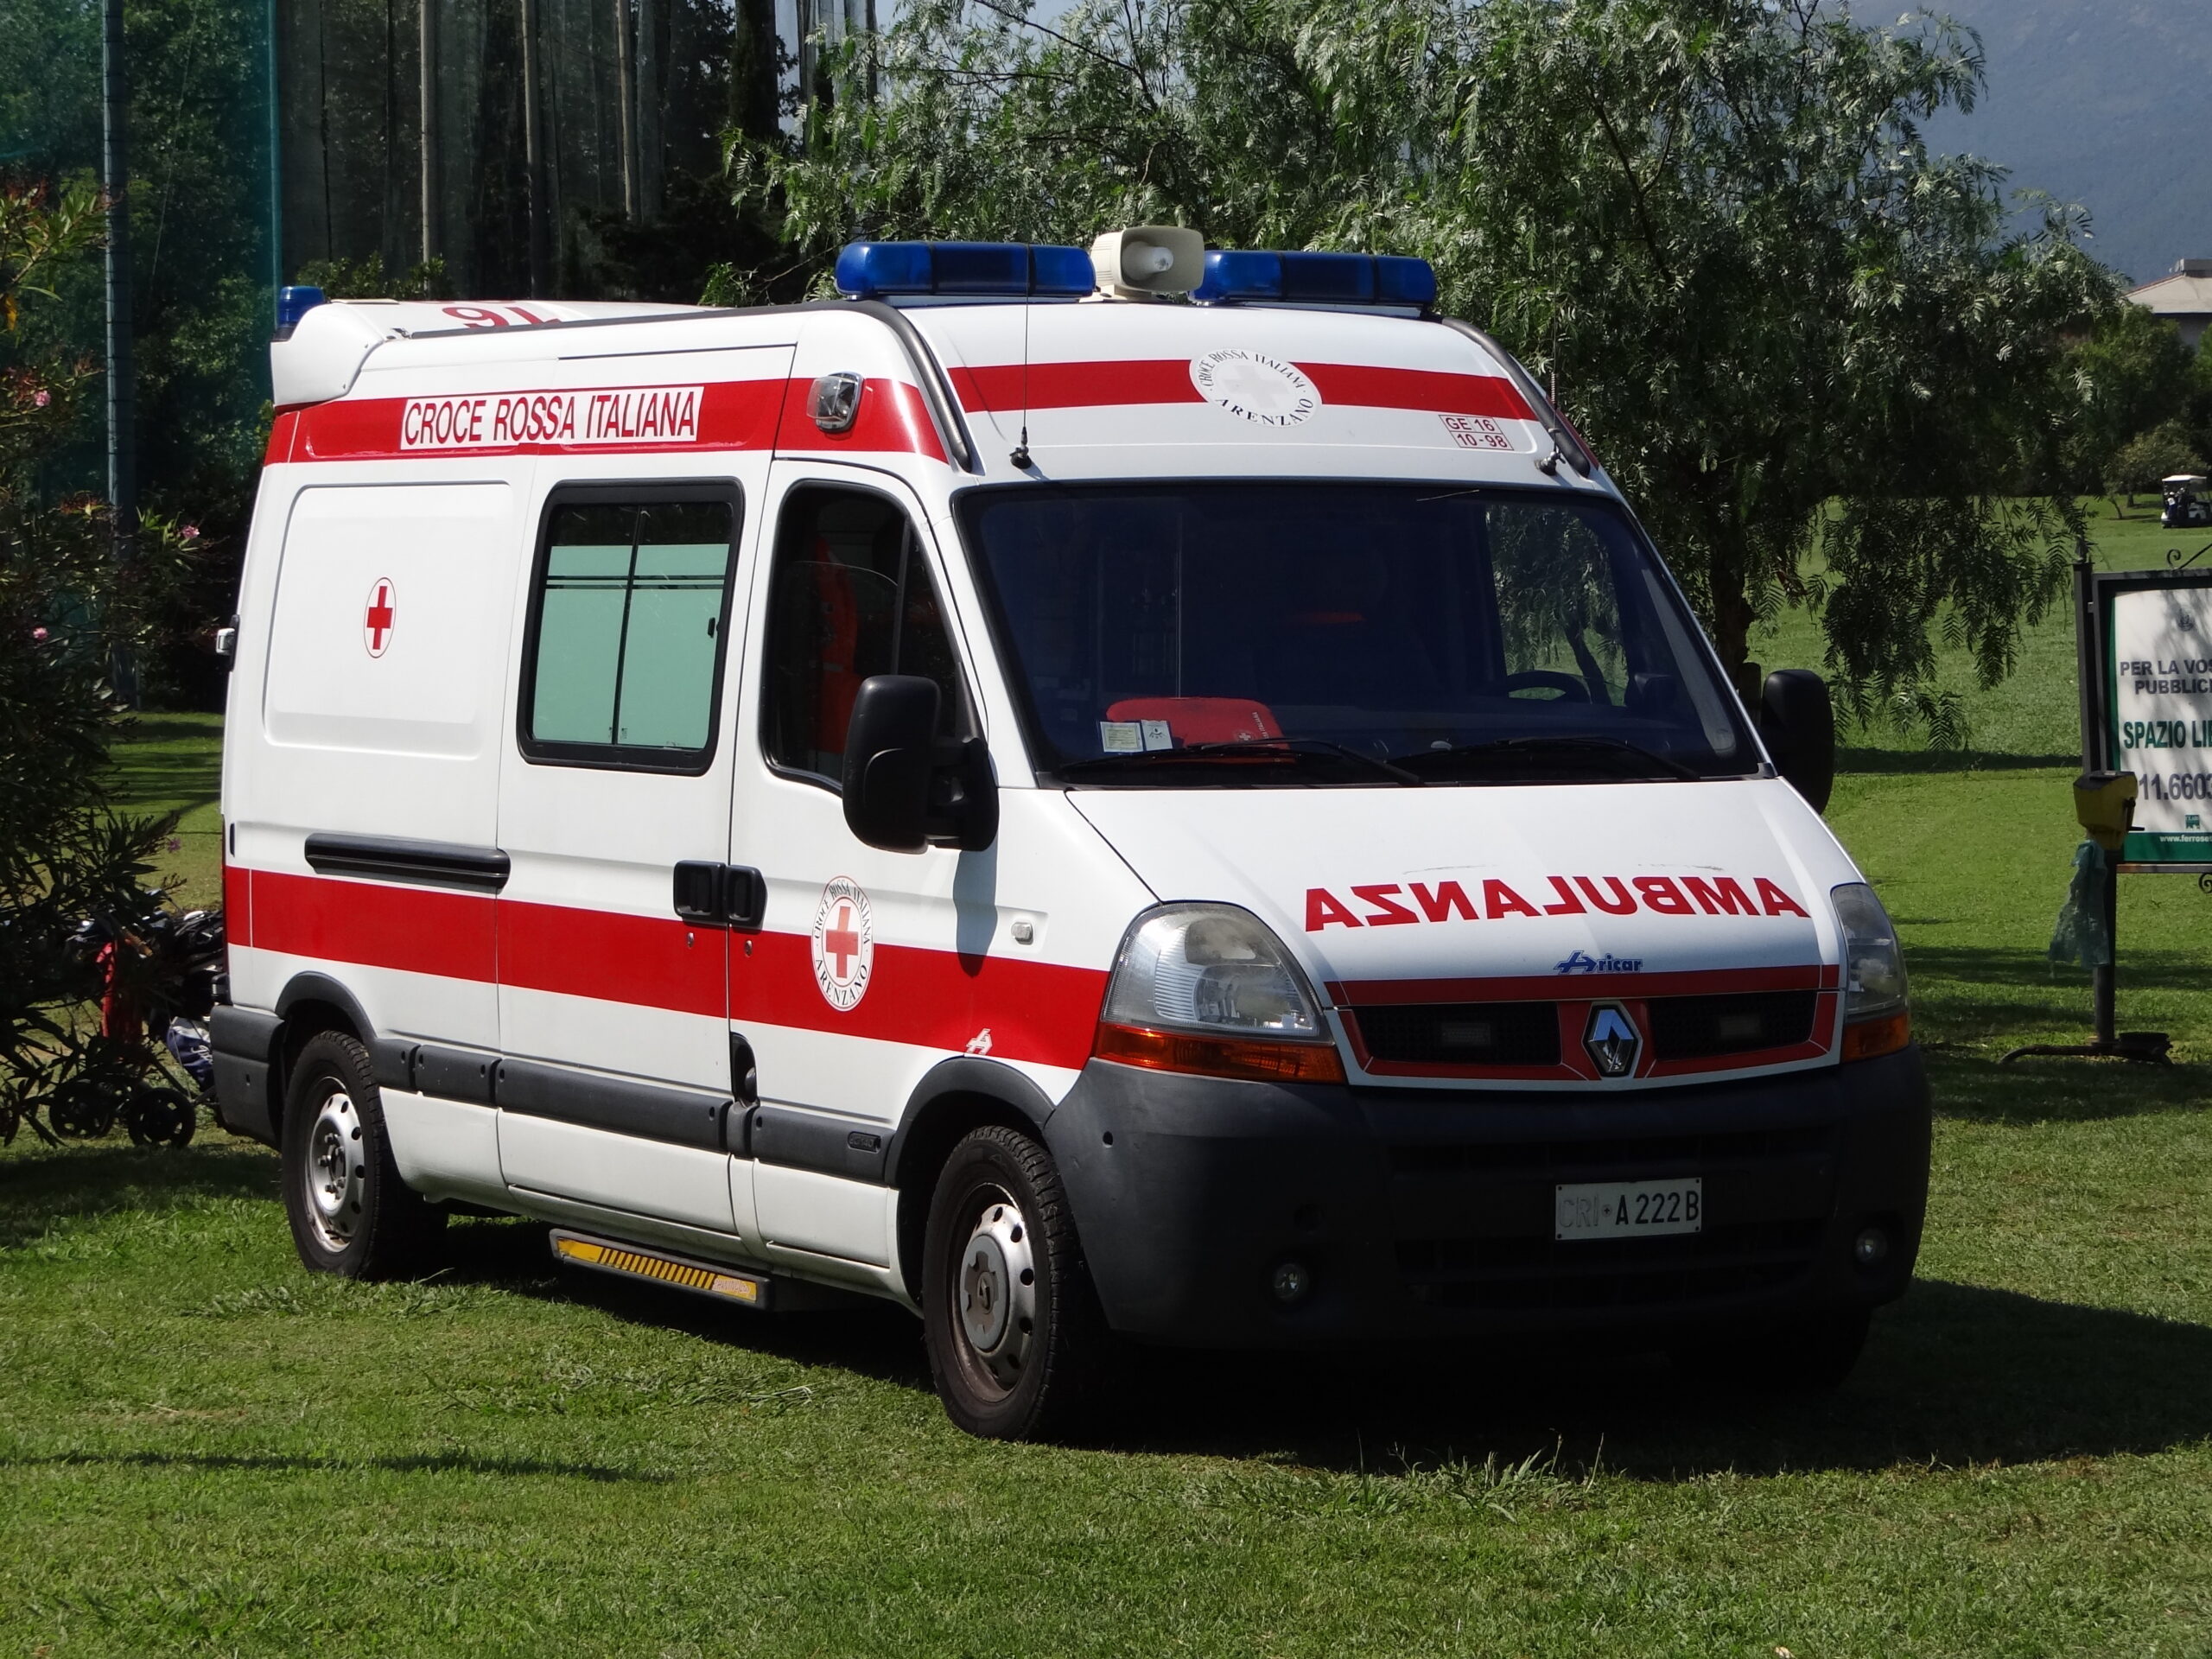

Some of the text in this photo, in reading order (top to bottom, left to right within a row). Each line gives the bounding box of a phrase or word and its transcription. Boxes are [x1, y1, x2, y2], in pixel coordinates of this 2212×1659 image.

[1198, 349, 1306, 388] CROCE ROSSA ITALIANA
[405, 391, 695, 445] CROCE ROSSA ITALIANA
[1215, 397, 1313, 427] ARENZANO
[1445, 417, 1495, 431] GE 16
[2120, 661, 2152, 675] PER
[2158, 660, 2179, 674] LA
[2124, 721, 2185, 748] SPAZIO
[815, 879, 871, 944] CROCE ROSSA ITALIANA
[1554, 950, 1643, 975] Aricar
[816, 959, 868, 1006] ARENZANO
[1560, 1194, 1600, 1228] CRI
